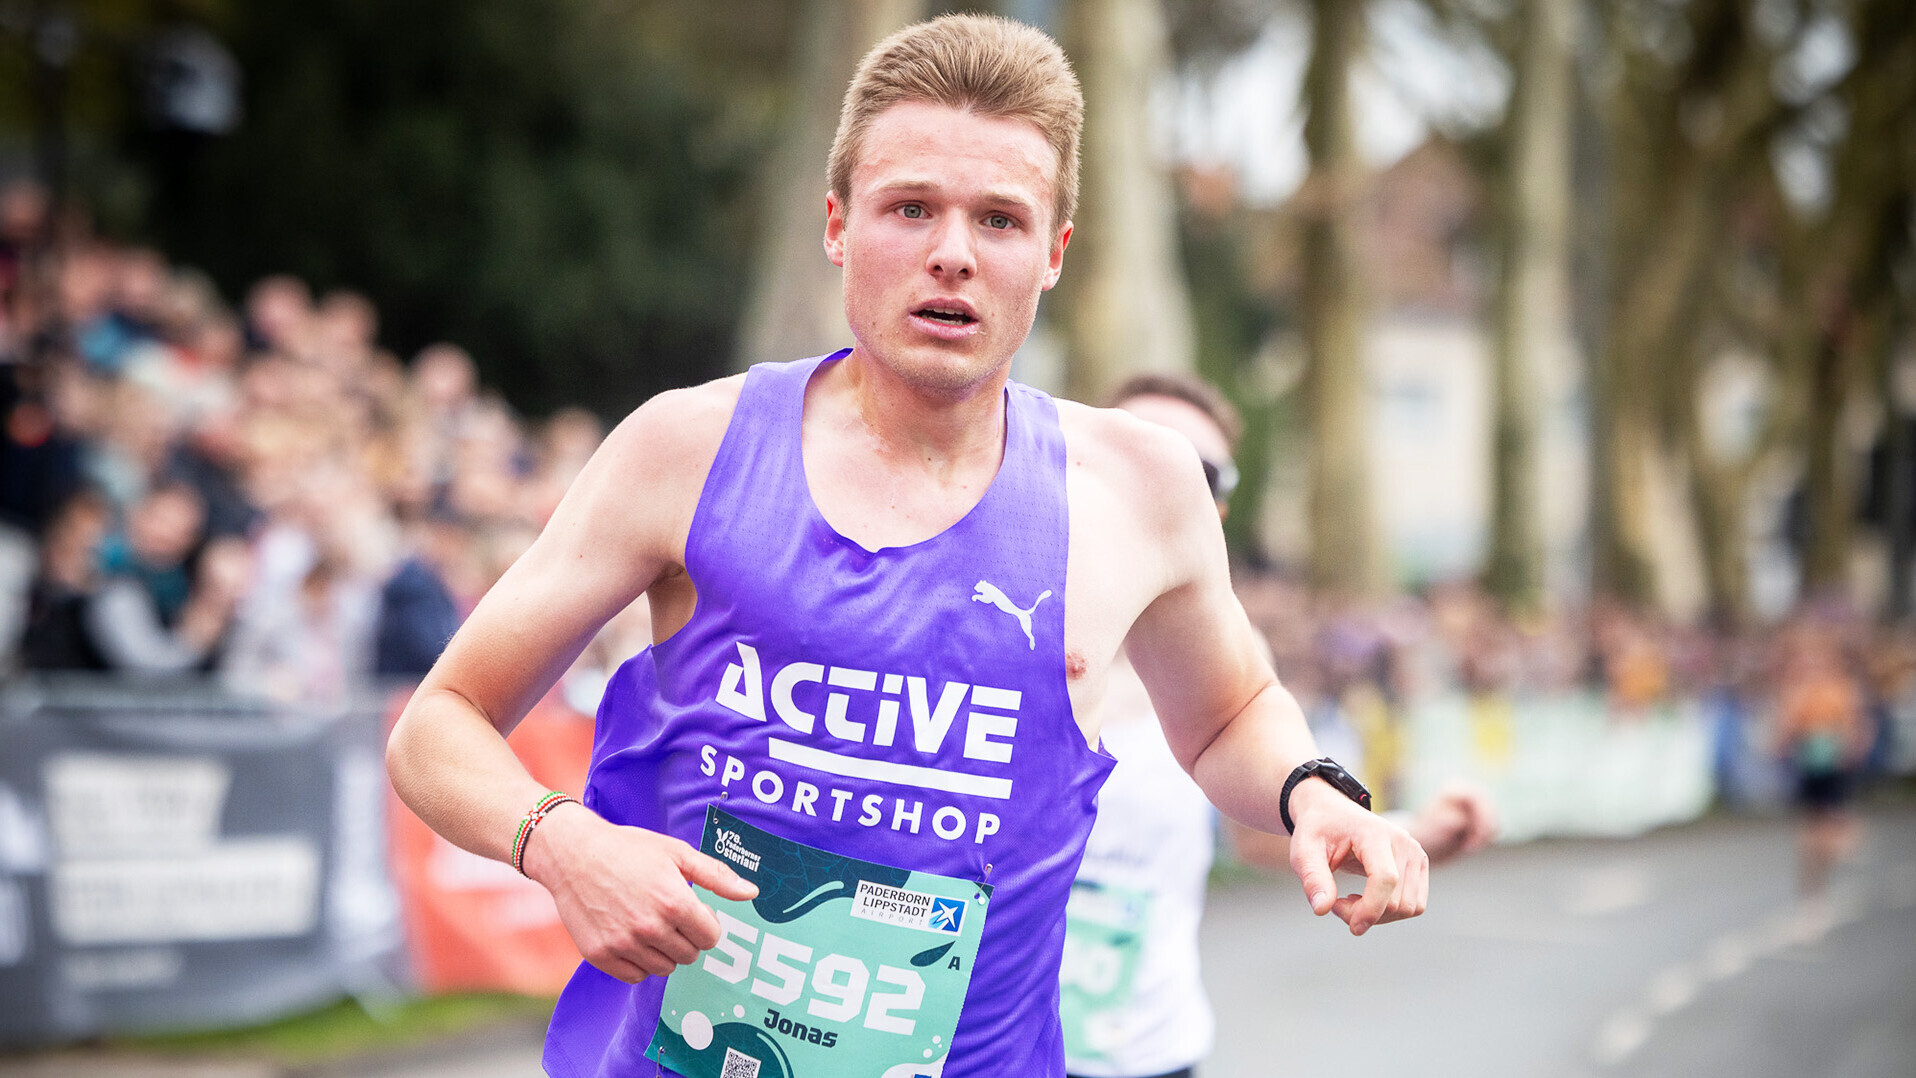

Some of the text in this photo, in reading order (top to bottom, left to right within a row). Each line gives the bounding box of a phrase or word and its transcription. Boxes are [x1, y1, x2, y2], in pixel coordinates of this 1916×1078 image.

[700, 744, 1001, 845] SPORTSHOP
[725, 839, 761, 862] Paderborner
[859, 883, 931, 906] PADERBORN
[860, 908, 923, 926] AIRPORT
[863, 897, 928, 918] LIPPSTADT
[702, 909, 926, 1036] 5592
[947, 956, 961, 971] A
[763, 1008, 838, 1049] Jonas
